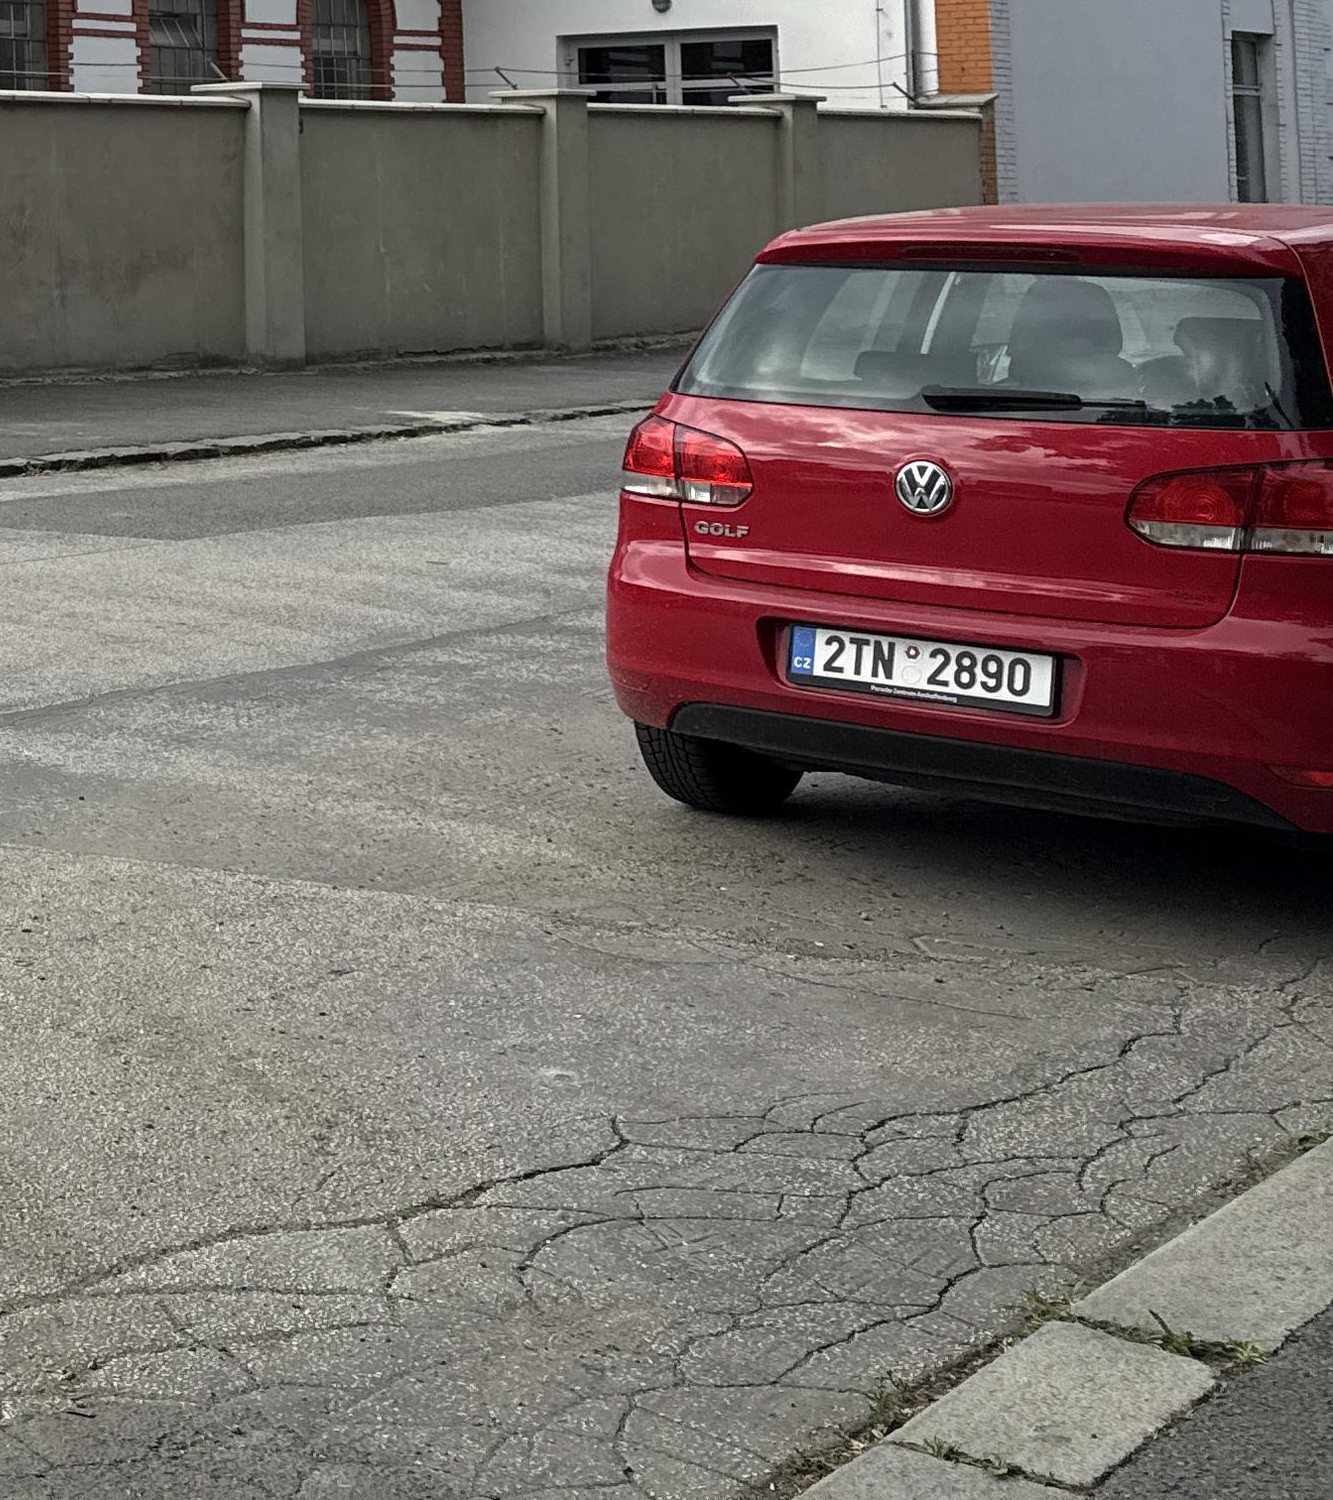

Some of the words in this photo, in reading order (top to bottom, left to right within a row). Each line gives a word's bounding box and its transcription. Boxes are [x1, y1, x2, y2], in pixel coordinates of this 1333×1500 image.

[694, 520, 749, 538] GOLF
[794, 656, 812, 669] CZ
[823, 635, 896, 680] 2TN
[927, 648, 1031, 697] 2890
